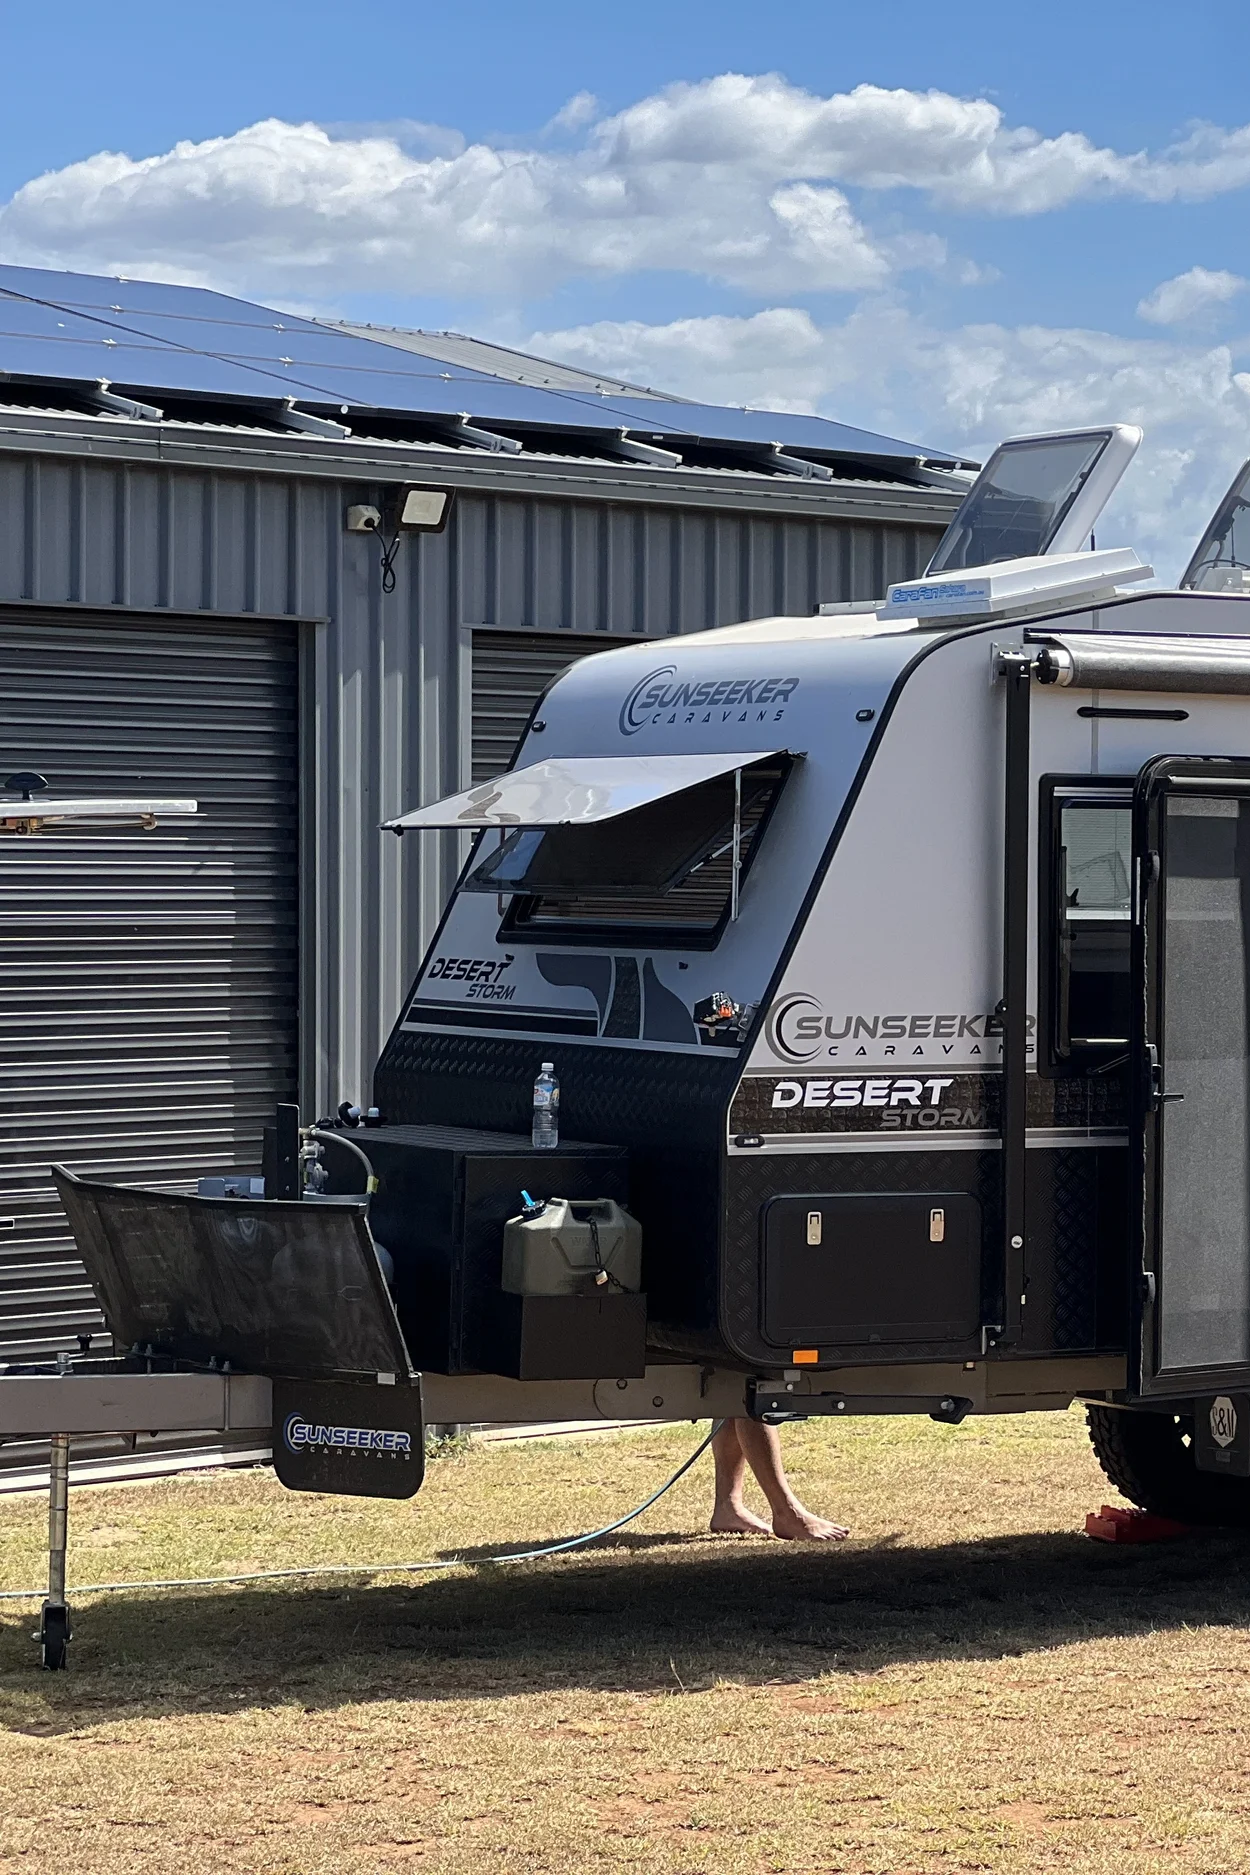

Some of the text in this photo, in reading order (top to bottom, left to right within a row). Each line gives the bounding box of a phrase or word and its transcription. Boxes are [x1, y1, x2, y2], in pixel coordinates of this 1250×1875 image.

[637, 678, 800, 709] SUNSEEKER
[652, 709, 785, 724] CARAVANS
[427, 957, 511, 982] DESERT
[465, 983, 517, 1000] STORM
[771, 1078, 954, 1109] DESERT
[880, 1109, 985, 1127] STORM
[292, 1424, 411, 1451] SUNSEEKER
[310, 1446, 410, 1460] CARAVANS
